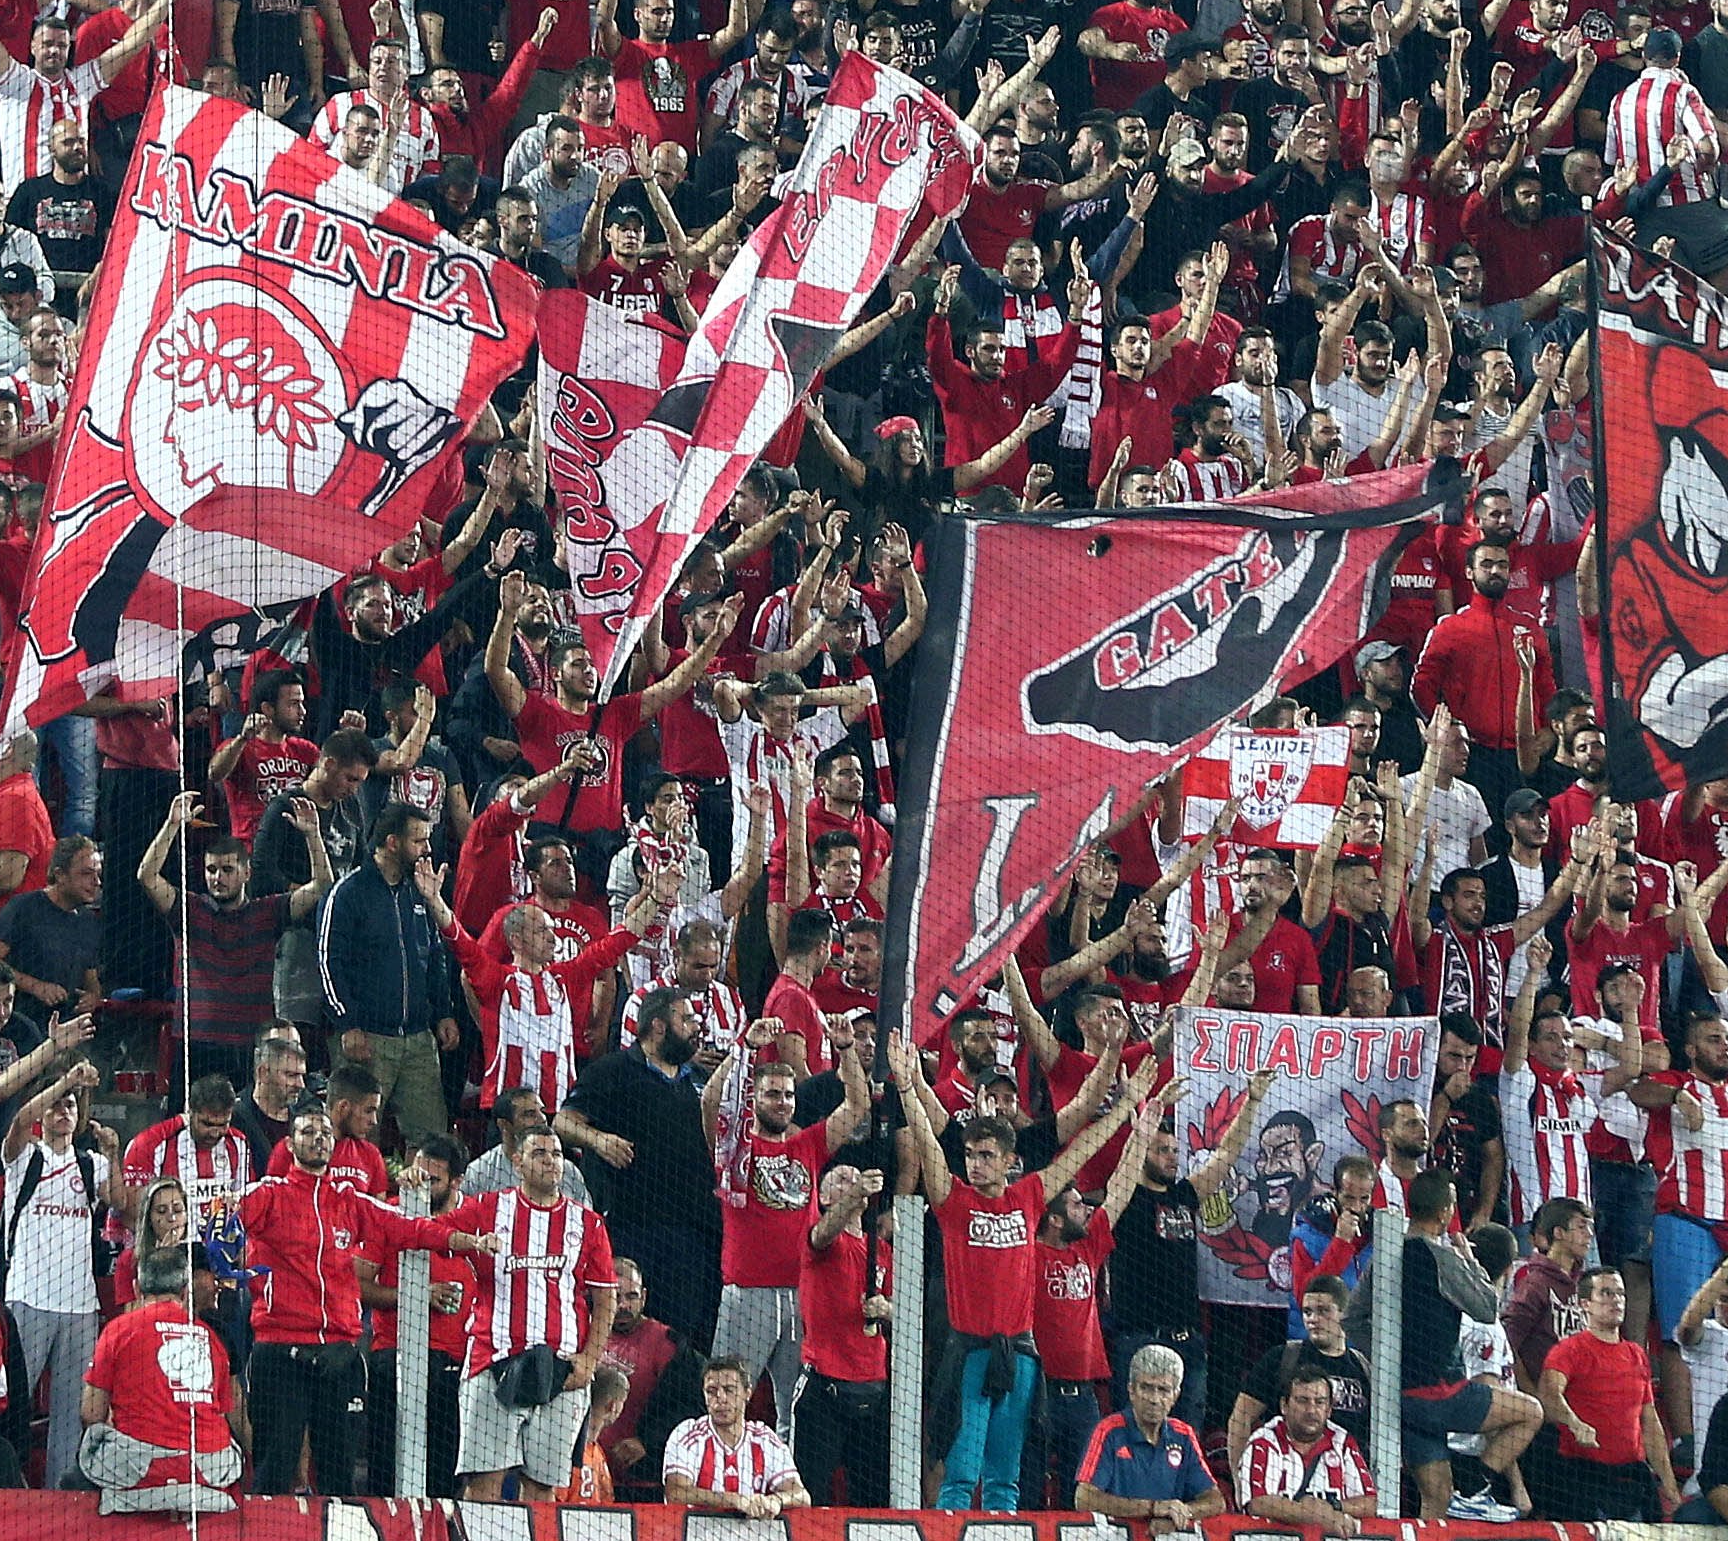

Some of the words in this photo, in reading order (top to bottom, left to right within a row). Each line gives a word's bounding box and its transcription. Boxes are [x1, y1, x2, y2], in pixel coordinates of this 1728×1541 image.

[130, 143, 506, 341] KAMINIA
[1093, 532, 1287, 691] GATE
[1190, 1017, 1424, 1082] ΣΠΑΡΤΗ
